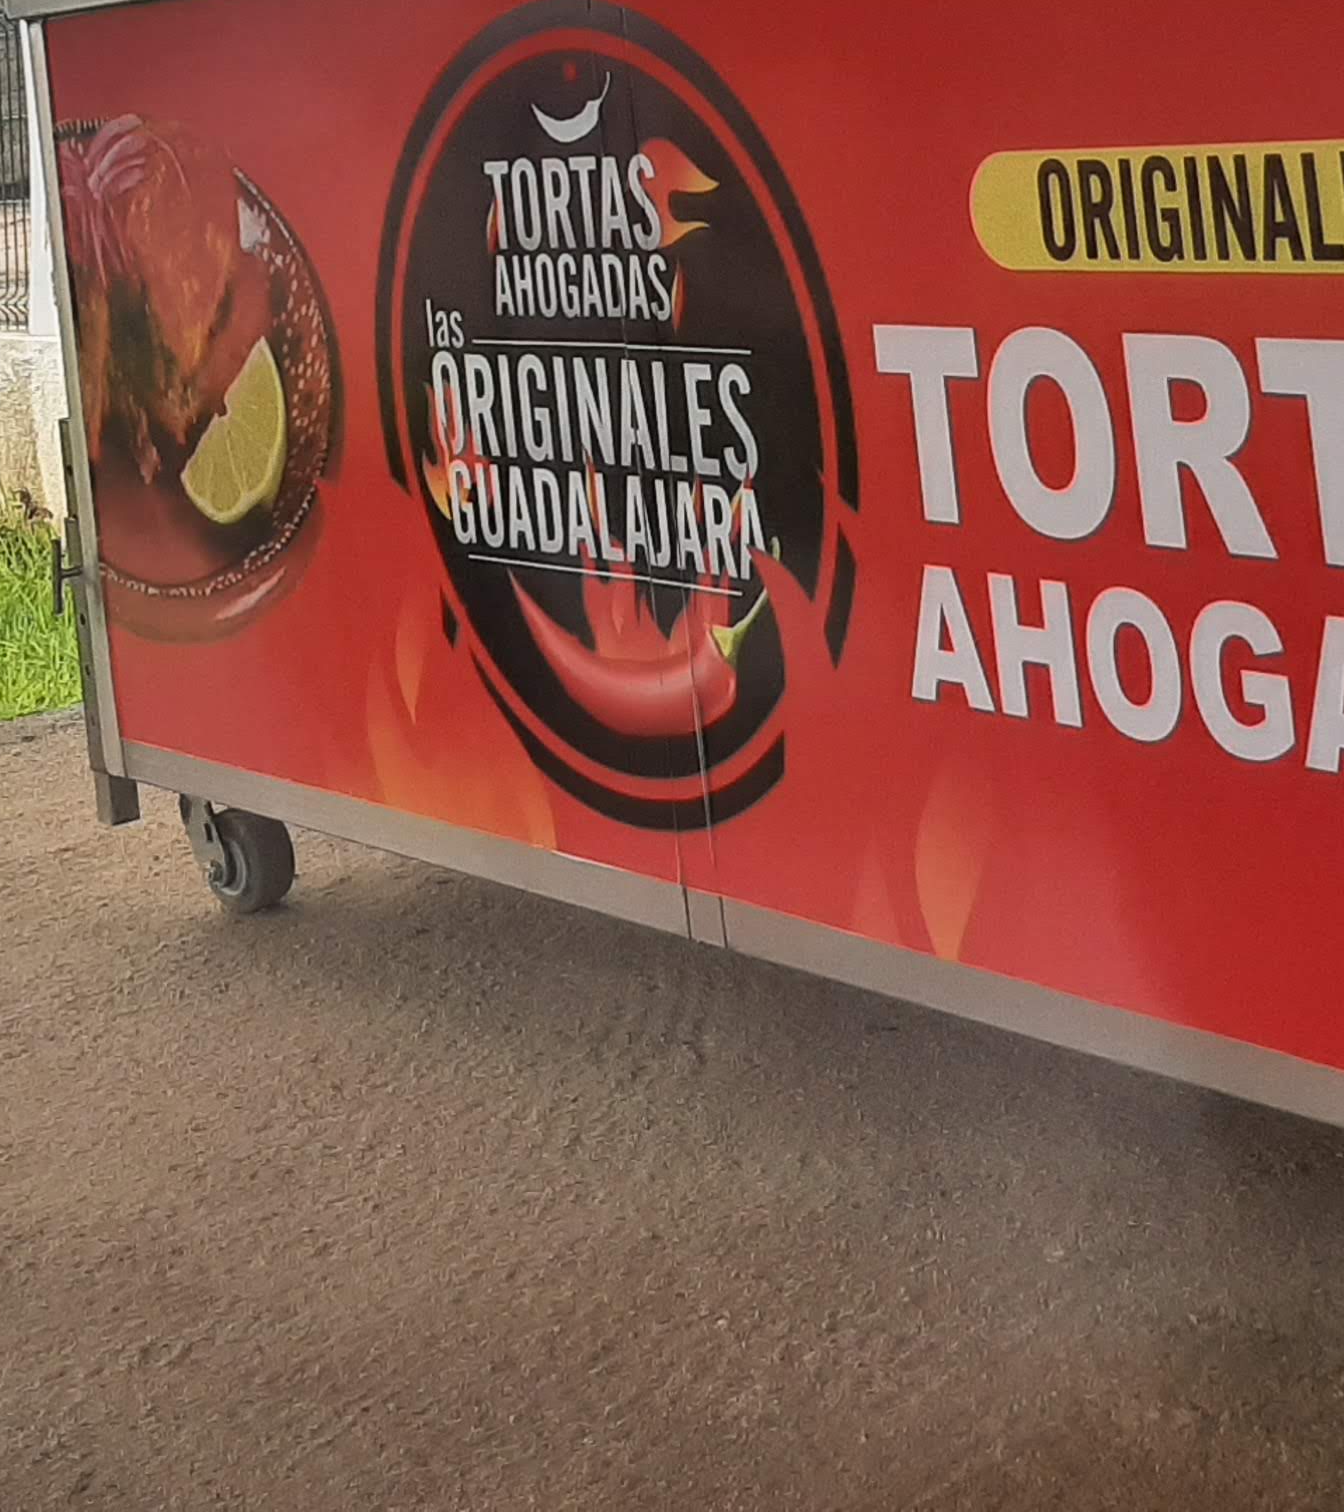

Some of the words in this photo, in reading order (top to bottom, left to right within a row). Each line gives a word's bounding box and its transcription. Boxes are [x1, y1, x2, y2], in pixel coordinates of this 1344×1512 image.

[484, 153, 660, 252] TORTAS
[425, 298, 464, 348] las
[495, 254, 671, 321] AHOGADAS
[432, 351, 758, 481] ORIGINALES
[449, 459, 766, 580] GUADALAJARA
